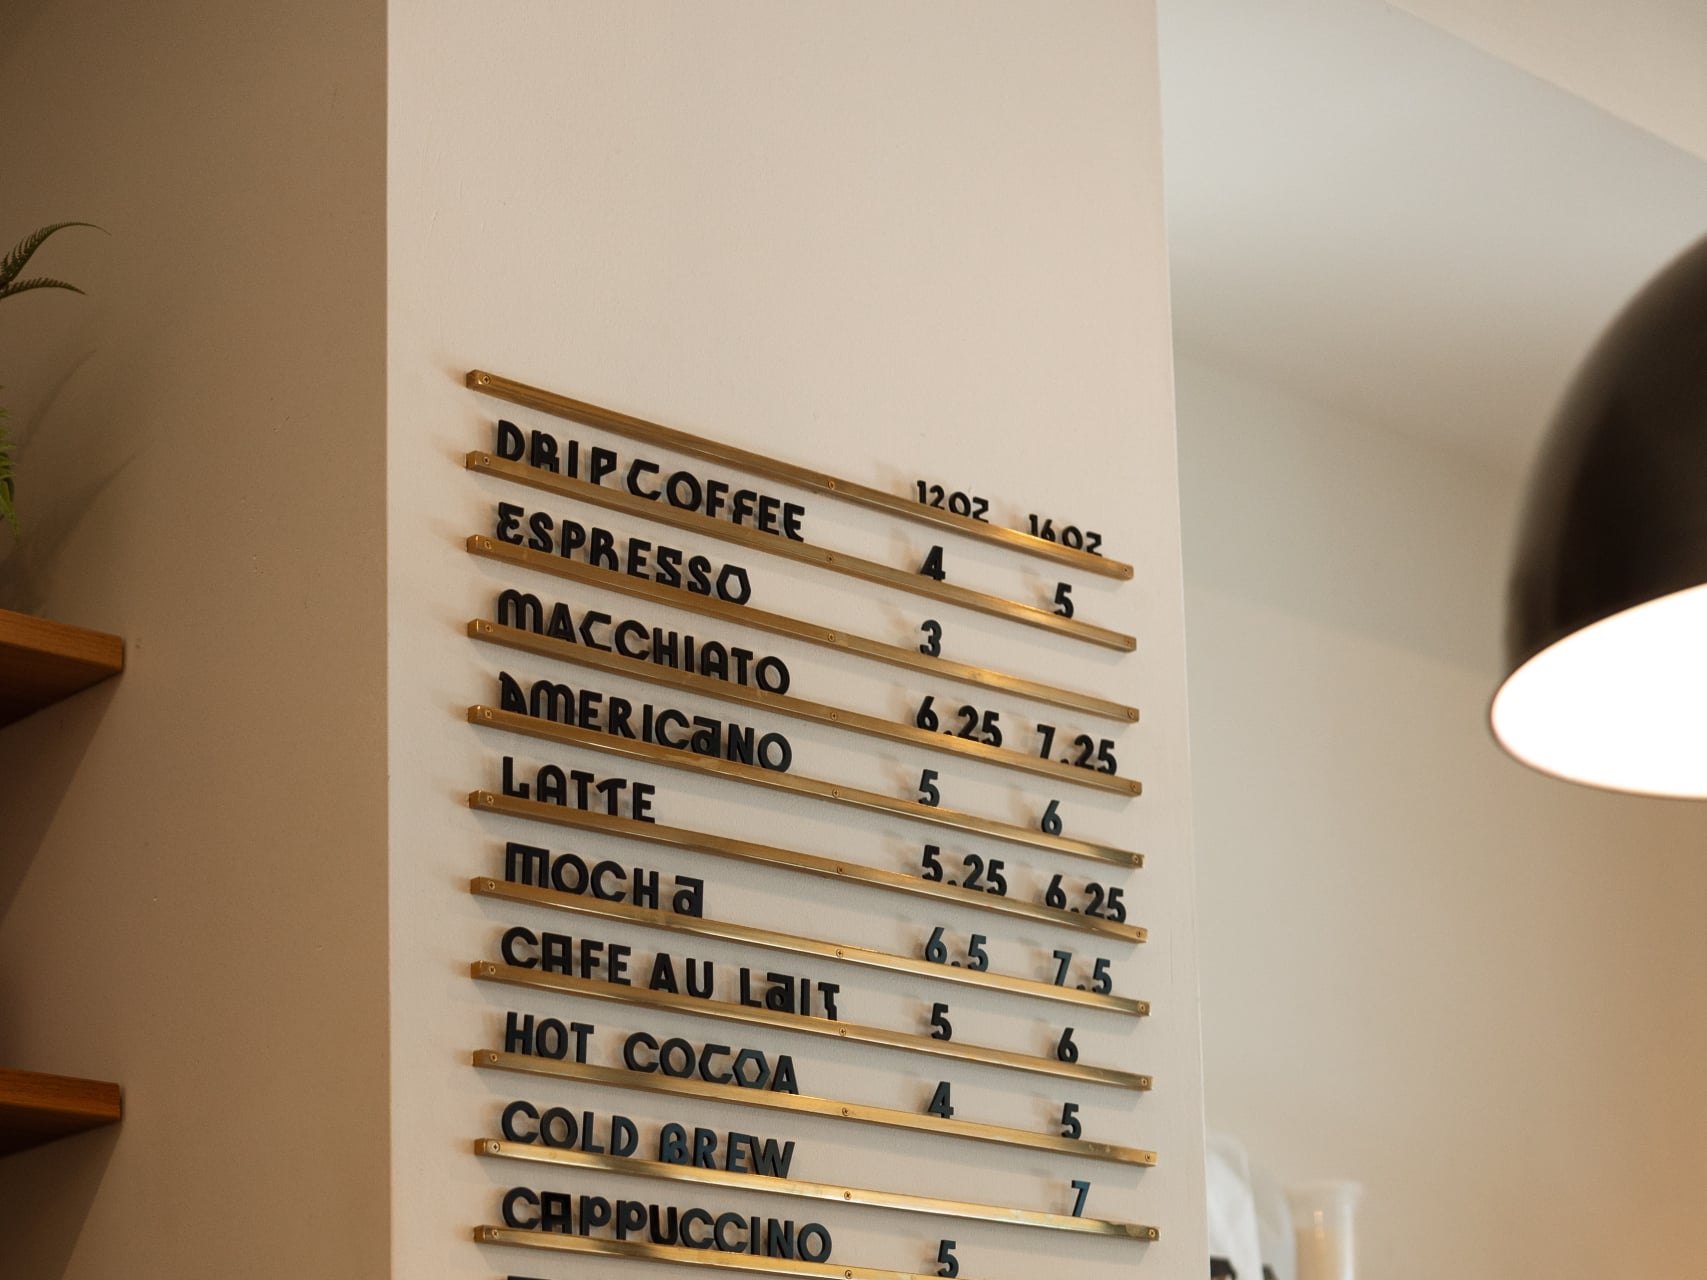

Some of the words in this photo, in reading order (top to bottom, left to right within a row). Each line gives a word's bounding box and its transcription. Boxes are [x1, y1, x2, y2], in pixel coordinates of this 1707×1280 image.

[497, 502, 751, 605] ESPRESSO
[920, 620, 942, 657] 3
[920, 545, 946, 580] 4
[1054, 582, 1074, 619] 5
[497, 589, 789, 695] MACCHIATO
[917, 696, 1002, 747] 6.25
[1037, 724, 1117, 776] 7.25
[503, 756, 655, 823] LATTE
[922, 845, 1007, 896] 5.25
[1045, 874, 1126, 923] 6.25
[919, 769, 939, 807] 5
[1041, 800, 1062, 836] 6
[501, 926, 631, 986] CAFE
[649, 953, 713, 998] AU
[931, 1003, 952, 1041] 5
[1057, 1028, 1078, 1063] 6
[925, 927, 988, 972] 6.5
[1053, 951, 1112, 995] 7.5
[505, 1011, 594, 1063] HOT
[624, 1031, 799, 1095] COCOA
[928, 1081, 953, 1119] 4
[1062, 1103, 1082, 1139] 5
[501, 1101, 638, 1157] COLD
[660, 1123, 795, 1178] BREW
[1072, 1180, 1091, 1217] 7
[938, 1240, 959, 1278] 5
